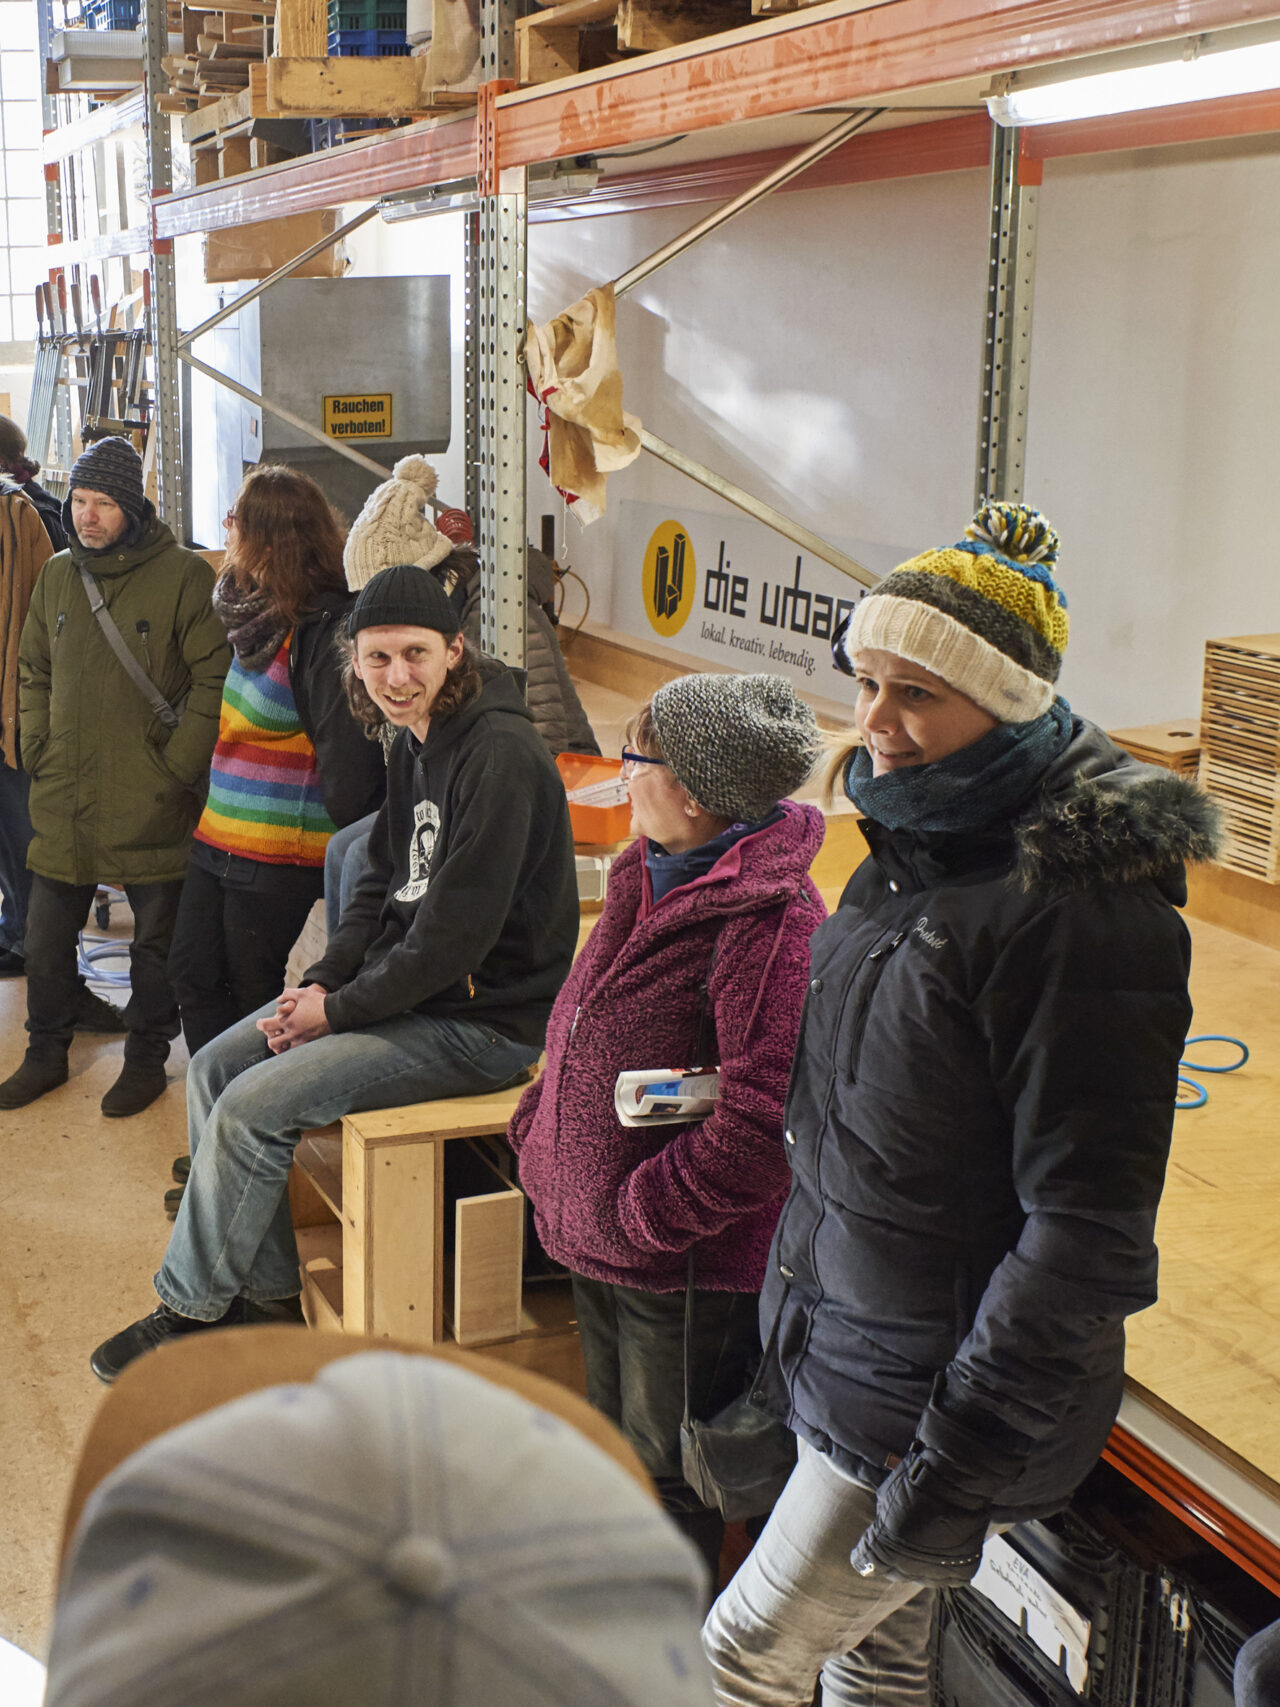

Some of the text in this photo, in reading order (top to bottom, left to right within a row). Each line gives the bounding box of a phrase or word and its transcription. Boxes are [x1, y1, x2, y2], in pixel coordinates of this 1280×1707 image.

[333, 399, 384, 414] Rauchen
[331, 419, 385, 435] verboten!
[704, 541, 749, 618] die
[701, 621, 816, 677] lokal. kreativ. lebendig.
